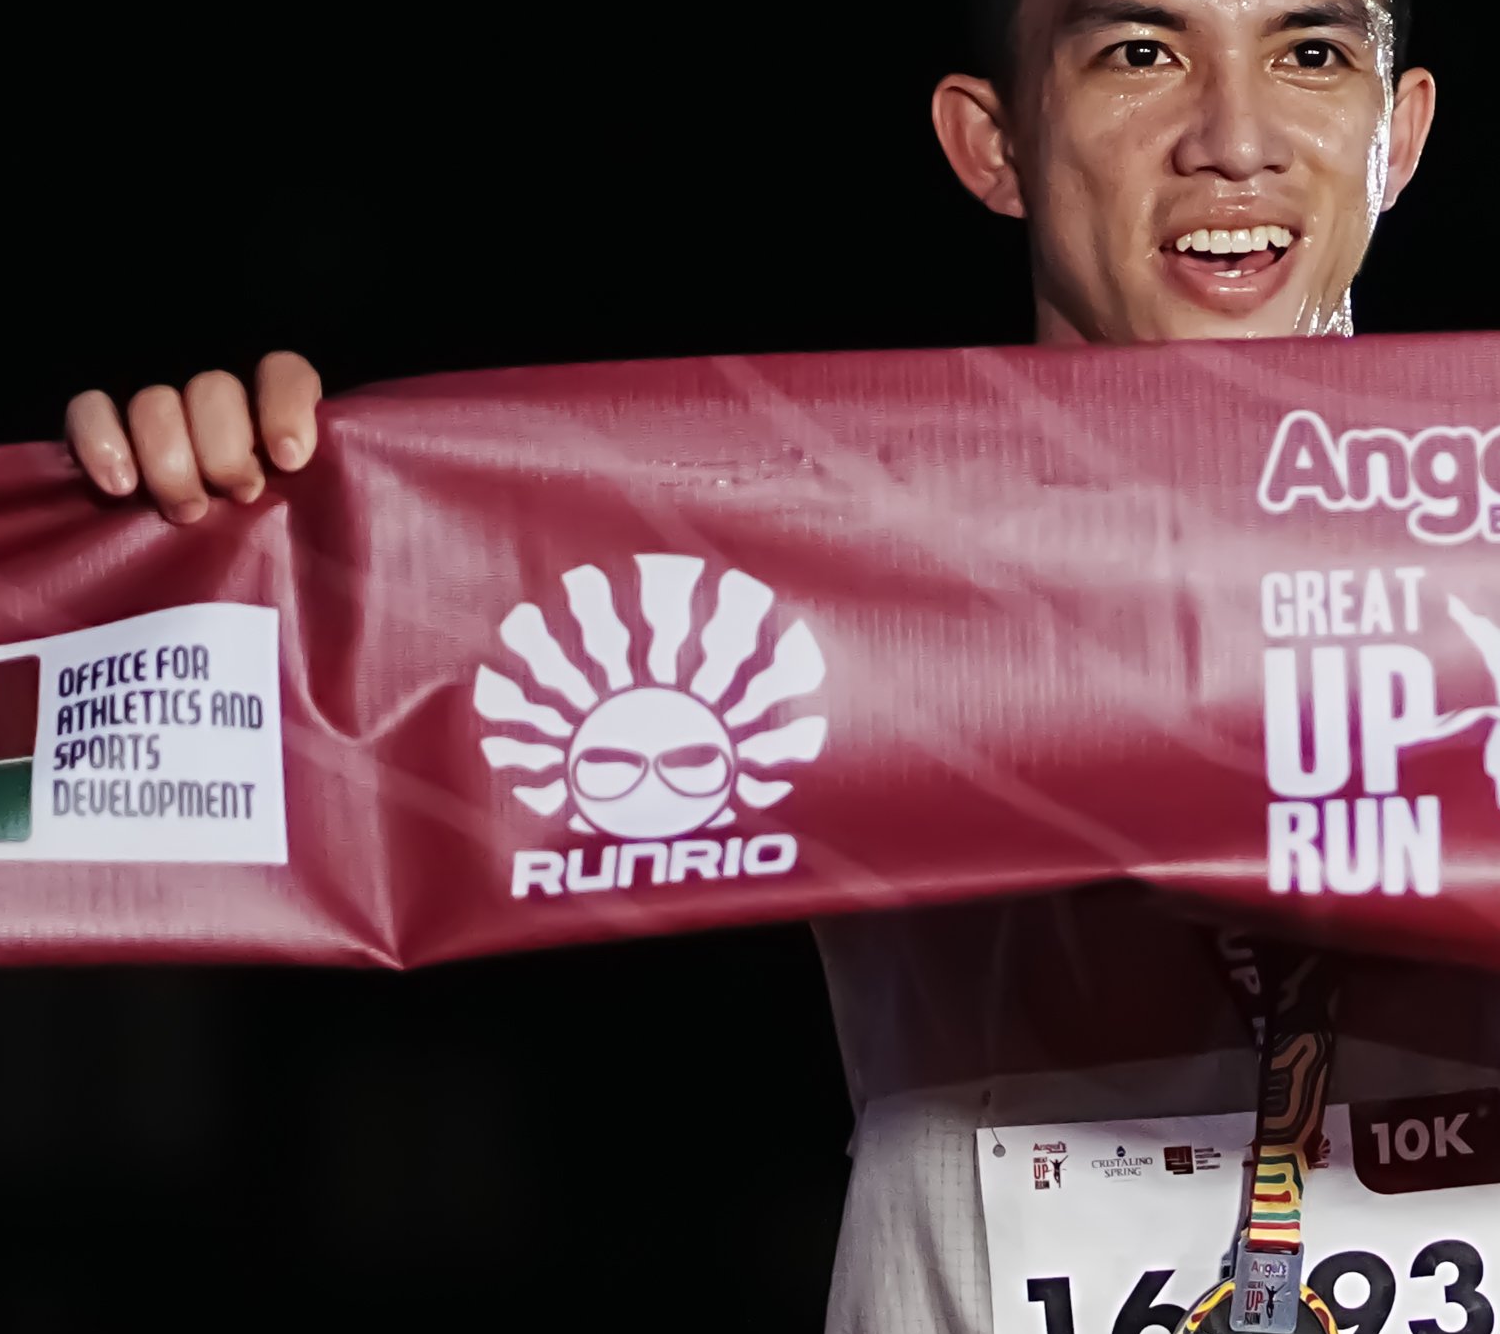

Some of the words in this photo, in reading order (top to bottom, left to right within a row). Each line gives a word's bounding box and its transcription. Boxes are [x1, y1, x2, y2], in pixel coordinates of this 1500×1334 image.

[1261, 567, 1426, 638] GREAT
[57, 648, 149, 698] OFFICE
[156, 644, 211, 682] FOR
[56, 688, 201, 737] ATHLETICS
[211, 690, 263, 730] AND
[1263, 643, 1438, 798] UP
[52, 733, 161, 772] SPORTS
[52, 778, 256, 820] DEVELOPMENT
[510, 833, 799, 900] RUNRIO
[1268, 795, 1441, 897] RUN
[1370, 1112, 1475, 1165] 10K
